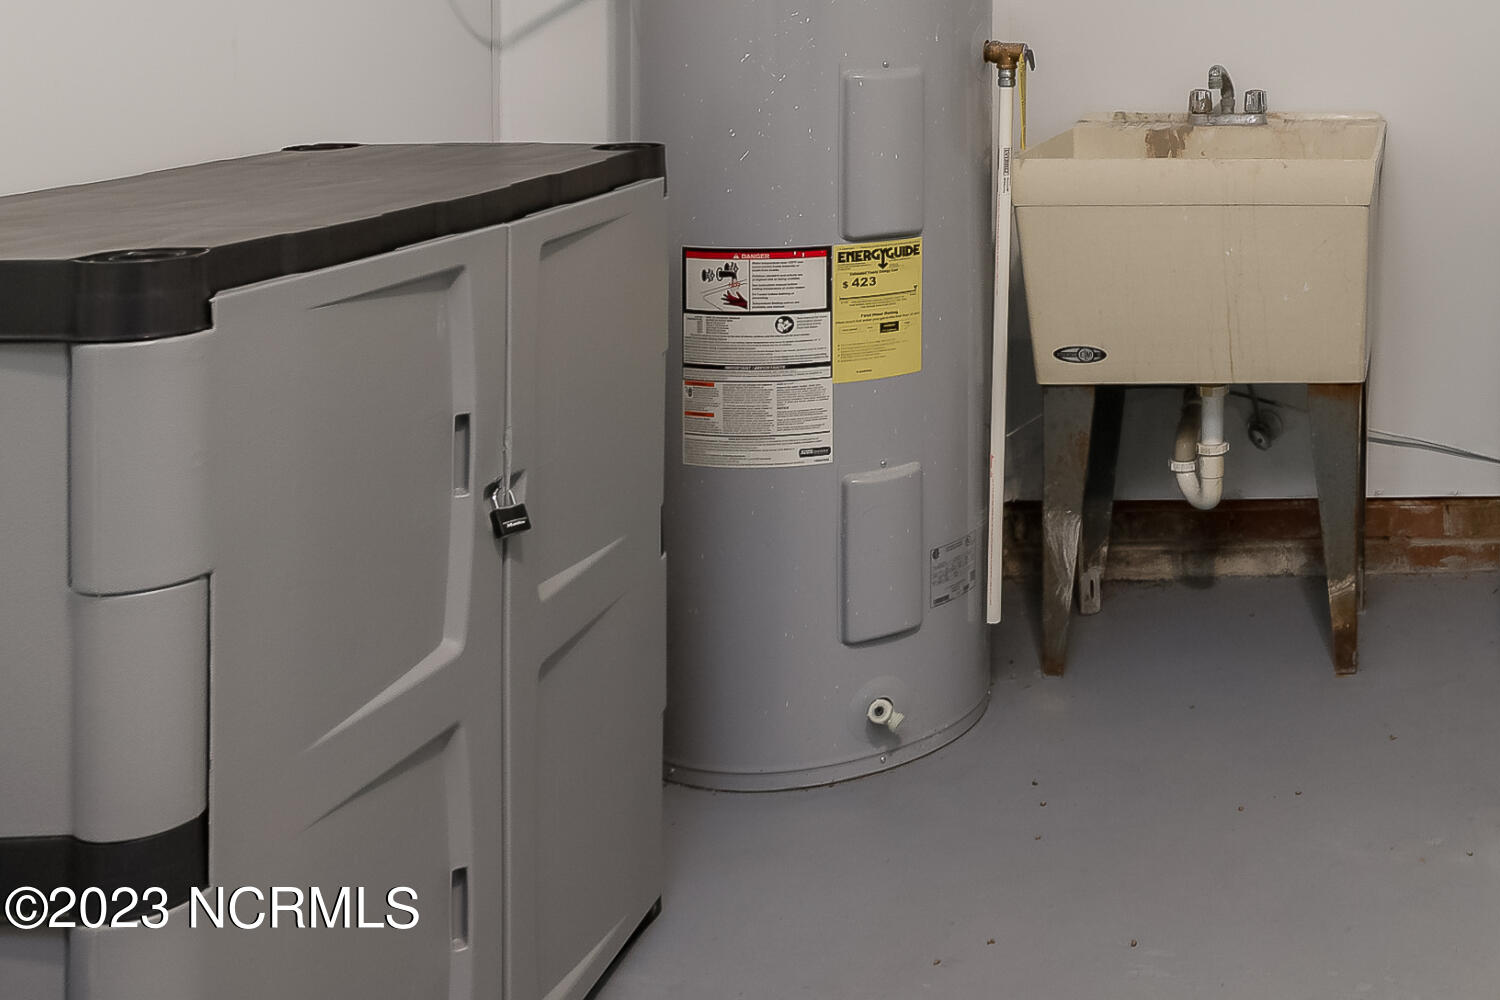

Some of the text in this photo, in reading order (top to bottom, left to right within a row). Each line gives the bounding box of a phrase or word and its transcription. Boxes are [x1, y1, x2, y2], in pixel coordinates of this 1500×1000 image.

[837, 244, 921, 264] ENERGYGUIDE
[842, 277, 877, 289] $ 423
